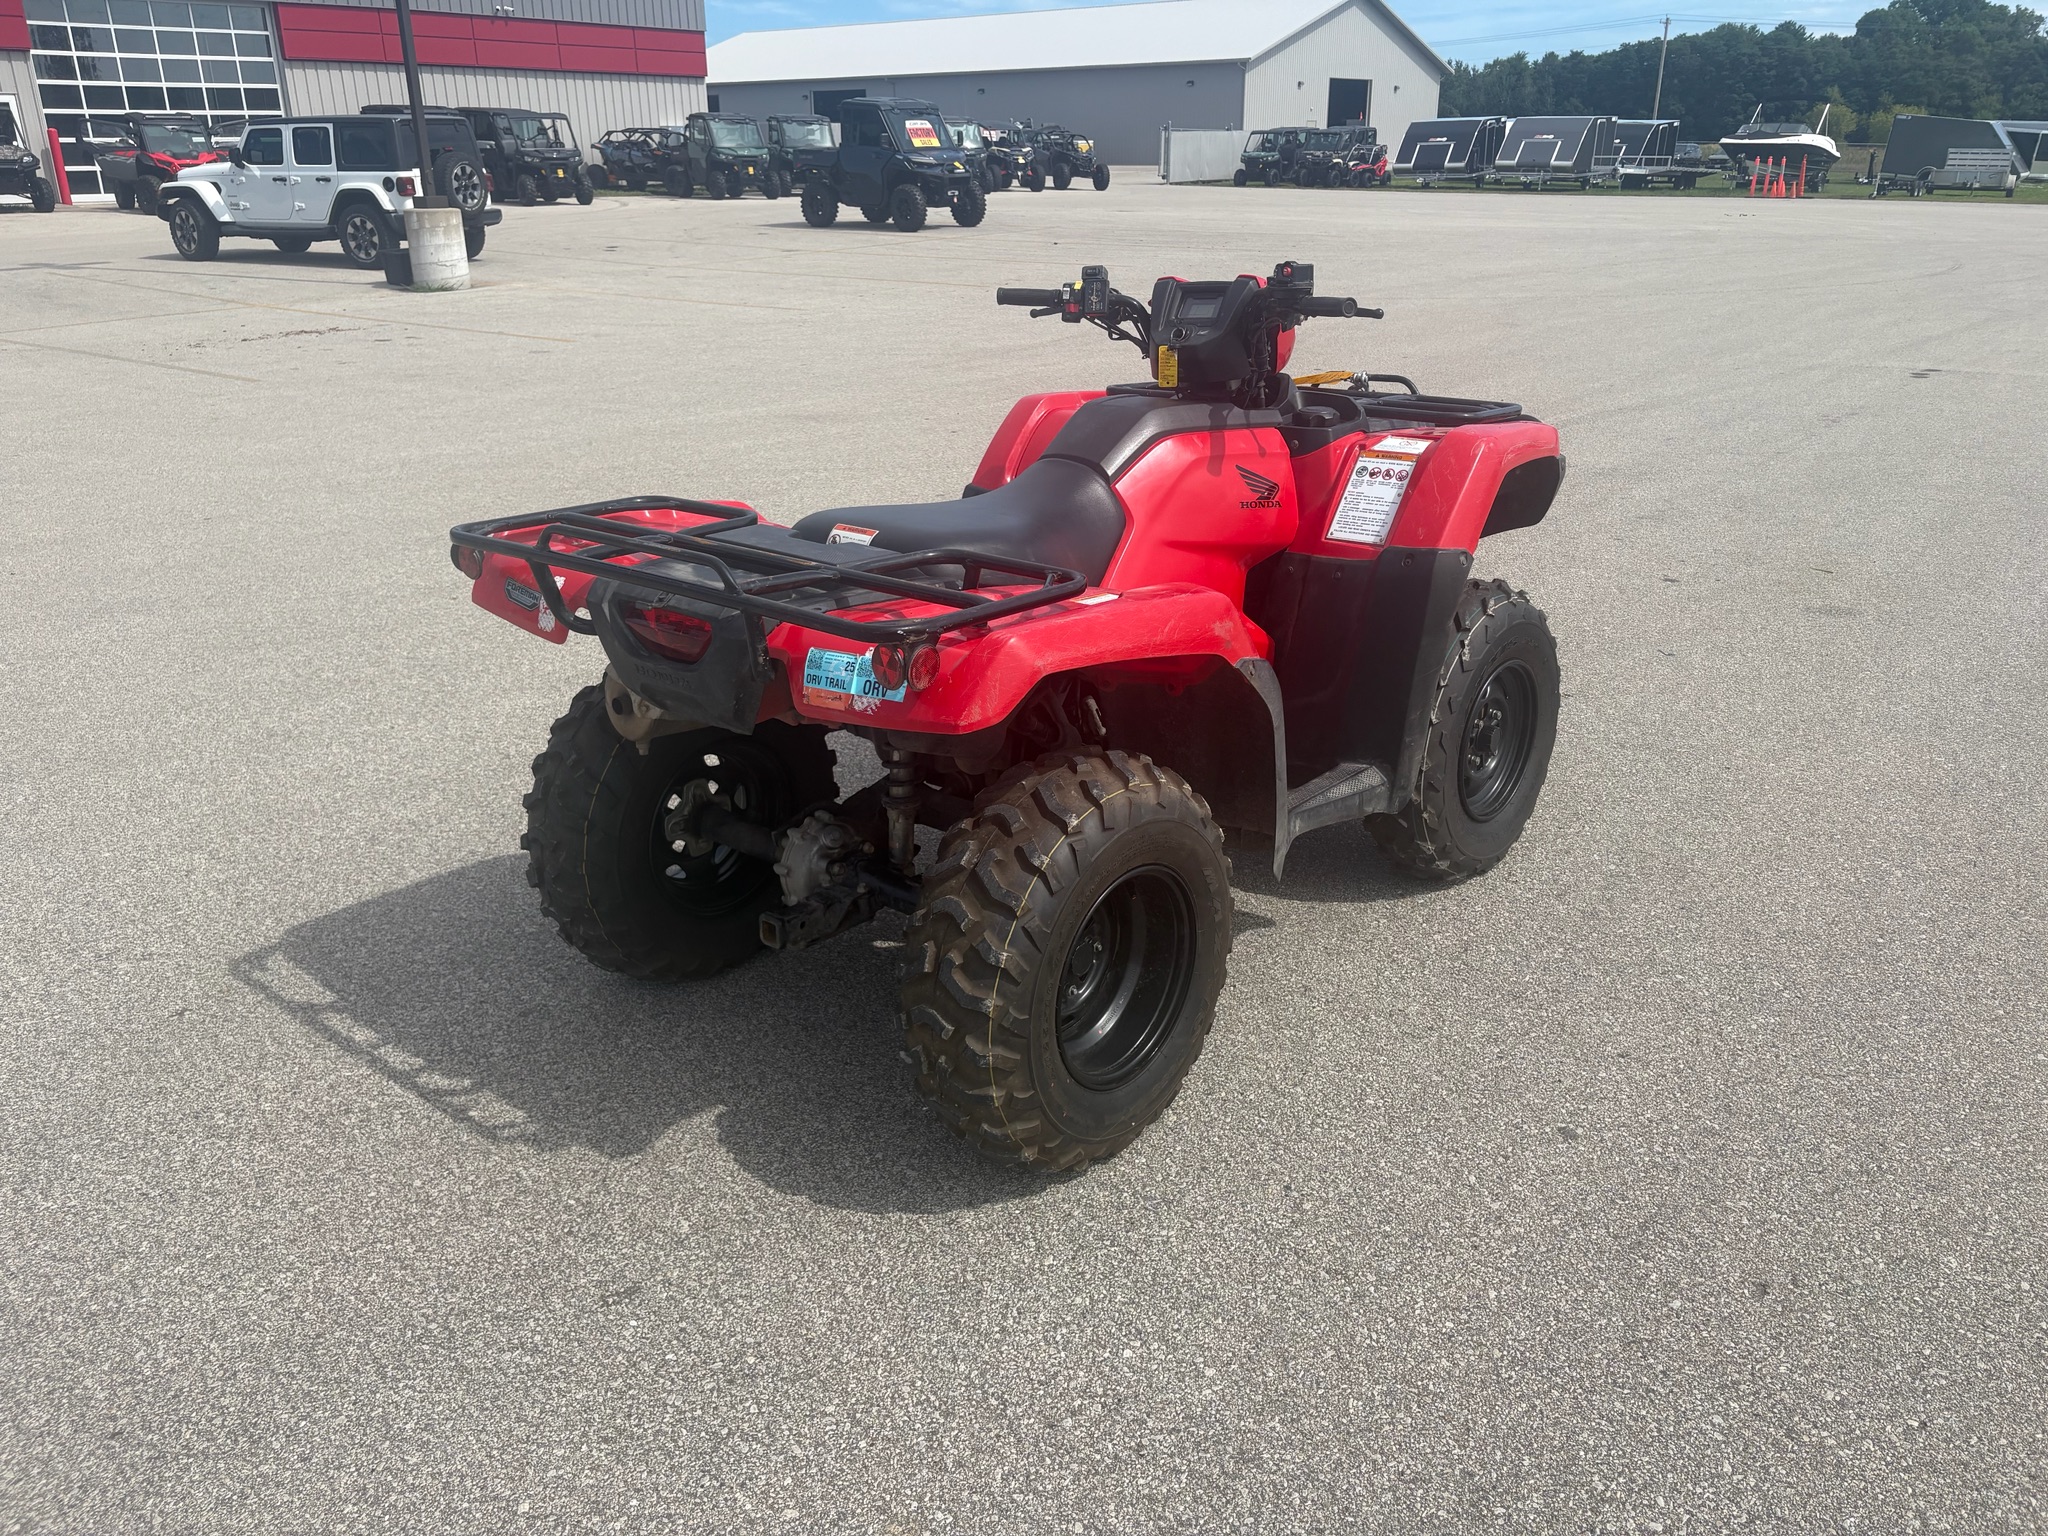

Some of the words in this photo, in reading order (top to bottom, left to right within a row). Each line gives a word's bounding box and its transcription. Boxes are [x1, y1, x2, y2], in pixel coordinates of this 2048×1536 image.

[1239, 500, 1282, 509] HONDA
[506, 580, 540, 602] FOREMAN
[844, 661, 856, 673] 25
[806, 673, 823, 686] ORV
[824, 676, 847, 690] TRAIL
[862, 679, 889, 698] ORV
